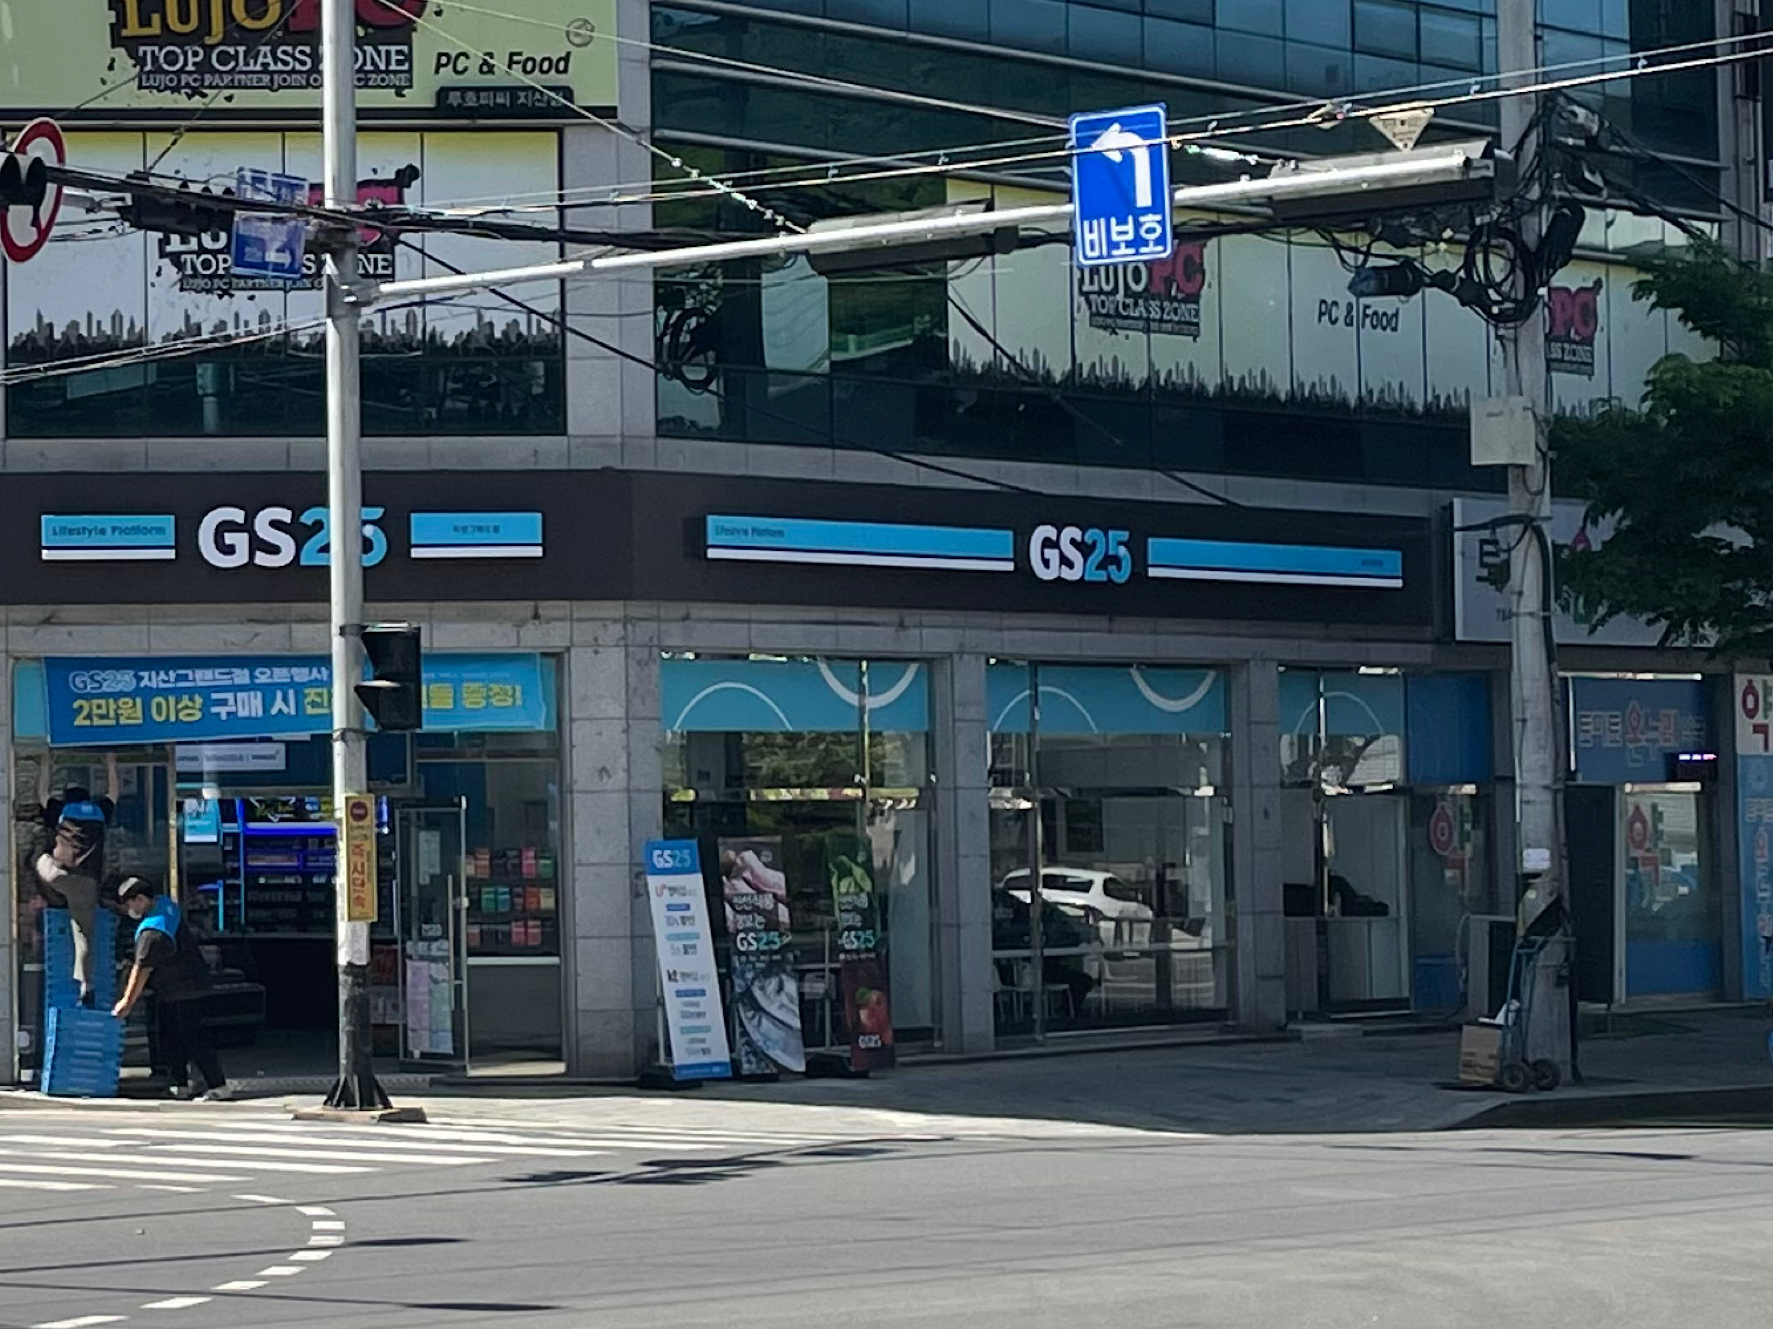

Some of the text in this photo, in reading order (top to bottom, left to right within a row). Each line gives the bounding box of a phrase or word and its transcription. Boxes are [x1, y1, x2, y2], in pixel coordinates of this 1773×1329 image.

[138, 45, 204, 71] TOP
[211, 45, 312, 71] CLASS
[434, 51, 572, 75] PC & Food
[141, 73, 177, 88] LUJO
[181, 73, 201, 88] PC
[273, 73, 307, 89] JOIN
[368, 73, 410, 87] ZONE
[1083, 213, 1164, 258] 비보호
[181, 254, 232, 274] TOP
[1150, 244, 1204, 295] PC
[1089, 296, 1199, 321] TOP CLASS ZONE
[1317, 299, 1400, 333] PC & Food
[1550, 288, 1597, 338] PC
[53, 526, 106, 538] Lifestyle
[197, 506, 388, 569] GS25
[1029, 524, 1132, 583] GS25
[69, 670, 136, 693] GS25
[73, 695, 144, 726] 2만원
[151, 694, 203, 722] 이상
[210, 691, 263, 720] 구매
[270, 689, 296, 716] 시
[652, 850, 691, 868] GS25
[737, 932, 780, 951] GS25
